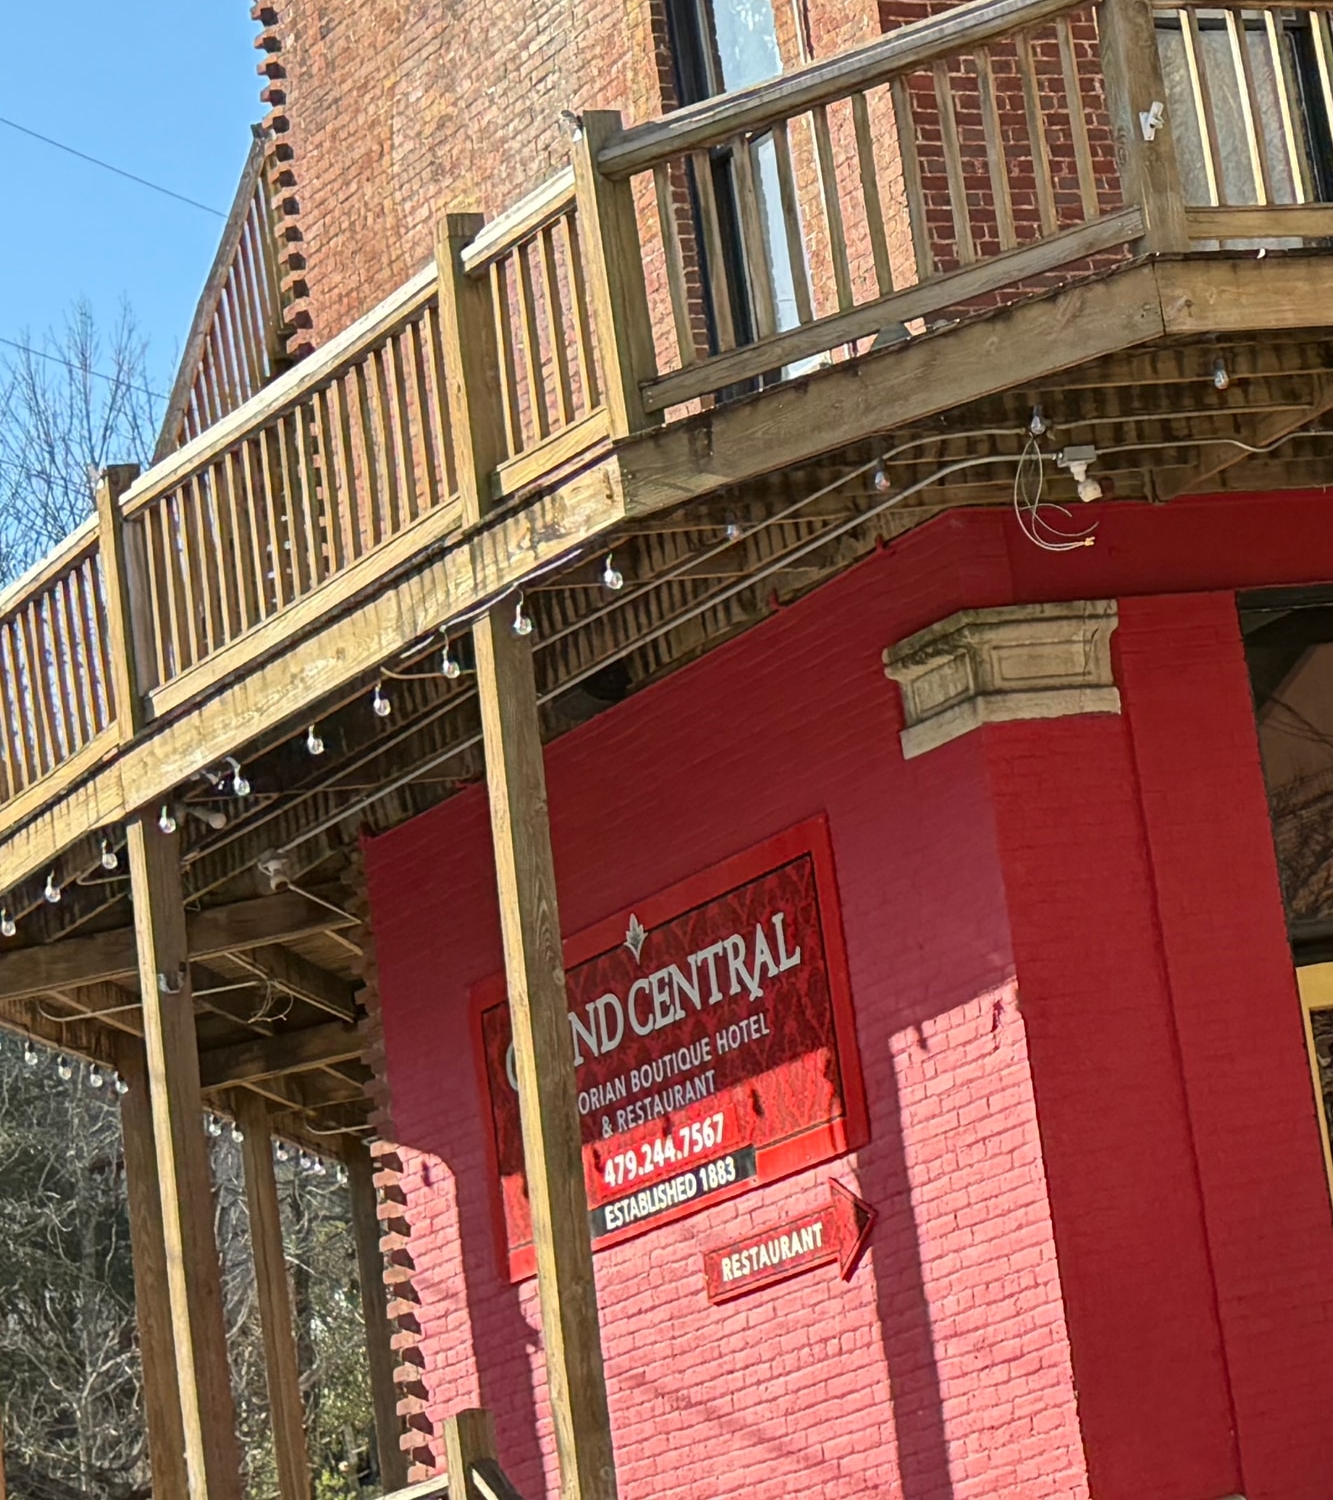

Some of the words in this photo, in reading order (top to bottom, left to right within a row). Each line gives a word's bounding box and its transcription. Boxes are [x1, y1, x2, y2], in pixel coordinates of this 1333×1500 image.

[628, 911, 801, 1036] CENTRAL
[577, 1074, 627, 1116] ORIAN
[630, 1037, 712, 1092] BOUTIQUE
[716, 1012, 771, 1055] HOTEL
[602, 1115, 615, 1138] &
[616, 1069, 716, 1135] RESTAURANT
[604, 1112, 725, 1188] 479.244.7567
[604, 1171, 697, 1230] ESTABLISHED
[699, 1157, 737, 1196] 1883
[721, 1221, 824, 1282] RESTAURANT
